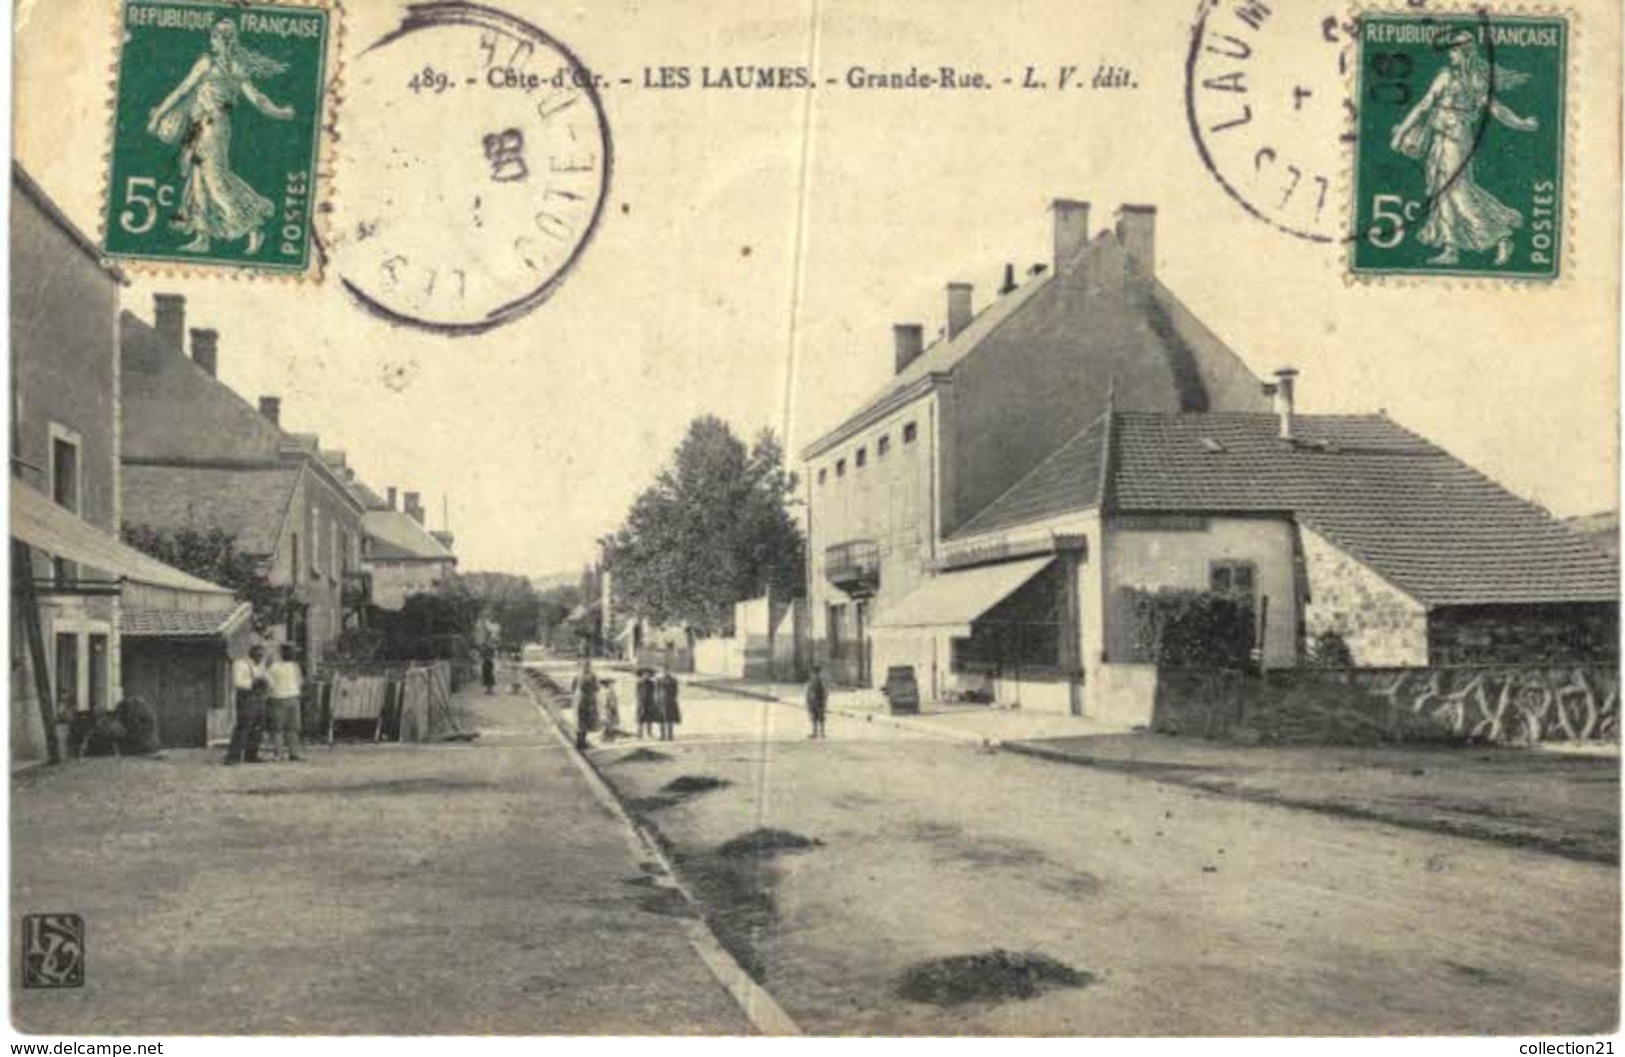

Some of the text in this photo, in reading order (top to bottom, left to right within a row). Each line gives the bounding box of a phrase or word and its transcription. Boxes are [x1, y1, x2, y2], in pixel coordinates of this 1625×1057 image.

[240, 13, 320, 38] FRANÇAISE
[407, 66, 456, 93] 489.
[642, 65, 692, 89] LES
[701, 65, 817, 89] LAUMES.
[846, 65, 992, 90] Grande-Rue.
[1022, 66, 1047, 89] L.
[1058, 66, 1084, 90] V.
[1092, 65, 1139, 90] édit.
[281, 170, 308, 255] POSTES
[1531, 180, 1554, 265] POSTES
